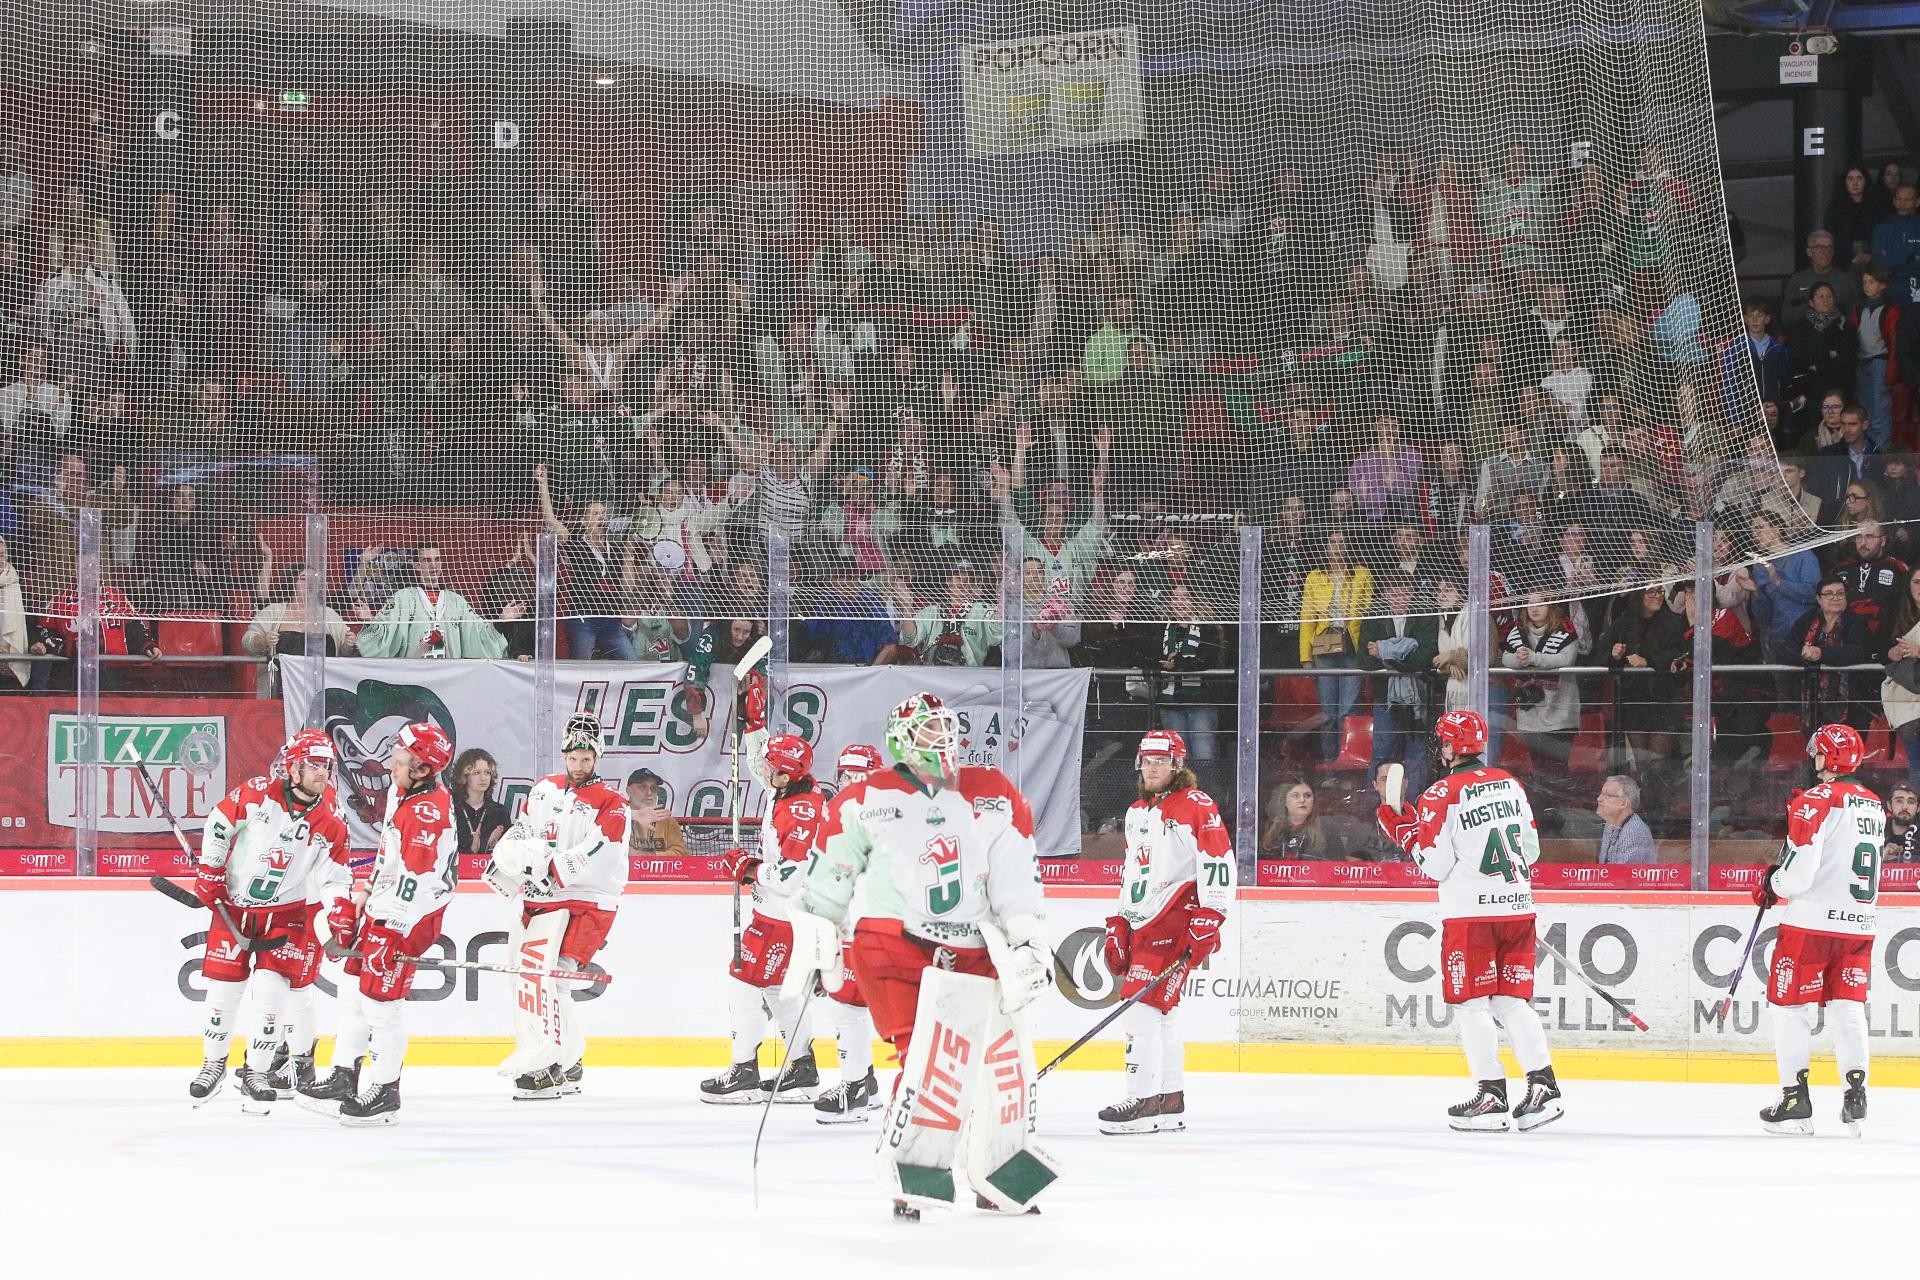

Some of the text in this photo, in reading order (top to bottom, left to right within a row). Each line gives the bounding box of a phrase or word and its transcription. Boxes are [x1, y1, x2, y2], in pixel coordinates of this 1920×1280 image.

[974, 33, 1124, 73] POPCORN
[1780, 60, 1817, 68] EVACUATION
[156, 111, 181, 139] C
[494, 121, 519, 149] D
[1804, 127, 1825, 156] E
[573, 681, 716, 755] LES
[61, 723, 209, 765] PIZZA
[59, 766, 214, 819] TIME
[411, 804, 440, 821] TLS
[789, 805, 816, 819] TLS
[976, 798, 1006, 812] PSC
[294, 823, 309, 841] C
[20, 854, 66, 867] somme
[102, 854, 150, 867] somme
[634, 860, 682, 873] somme
[1039, 864, 1079, 877] omme
[1204, 862, 1230, 887] 70
[1262, 864, 1310, 877] somme
[1334, 864, 1382, 878] somme
[1562, 867, 1608, 880] somme
[1631, 867, 1678, 880] somme
[1881, 867, 1920, 880] omme
[396, 875, 417, 902] 18
[1212, 978, 1340, 1002] CLIMATIQUE
[1229, 1006, 1338, 1019] GROUPE MENTION
[1386, 994, 1635, 1031] MUELLE
[889, 1087, 916, 1148] CCM
